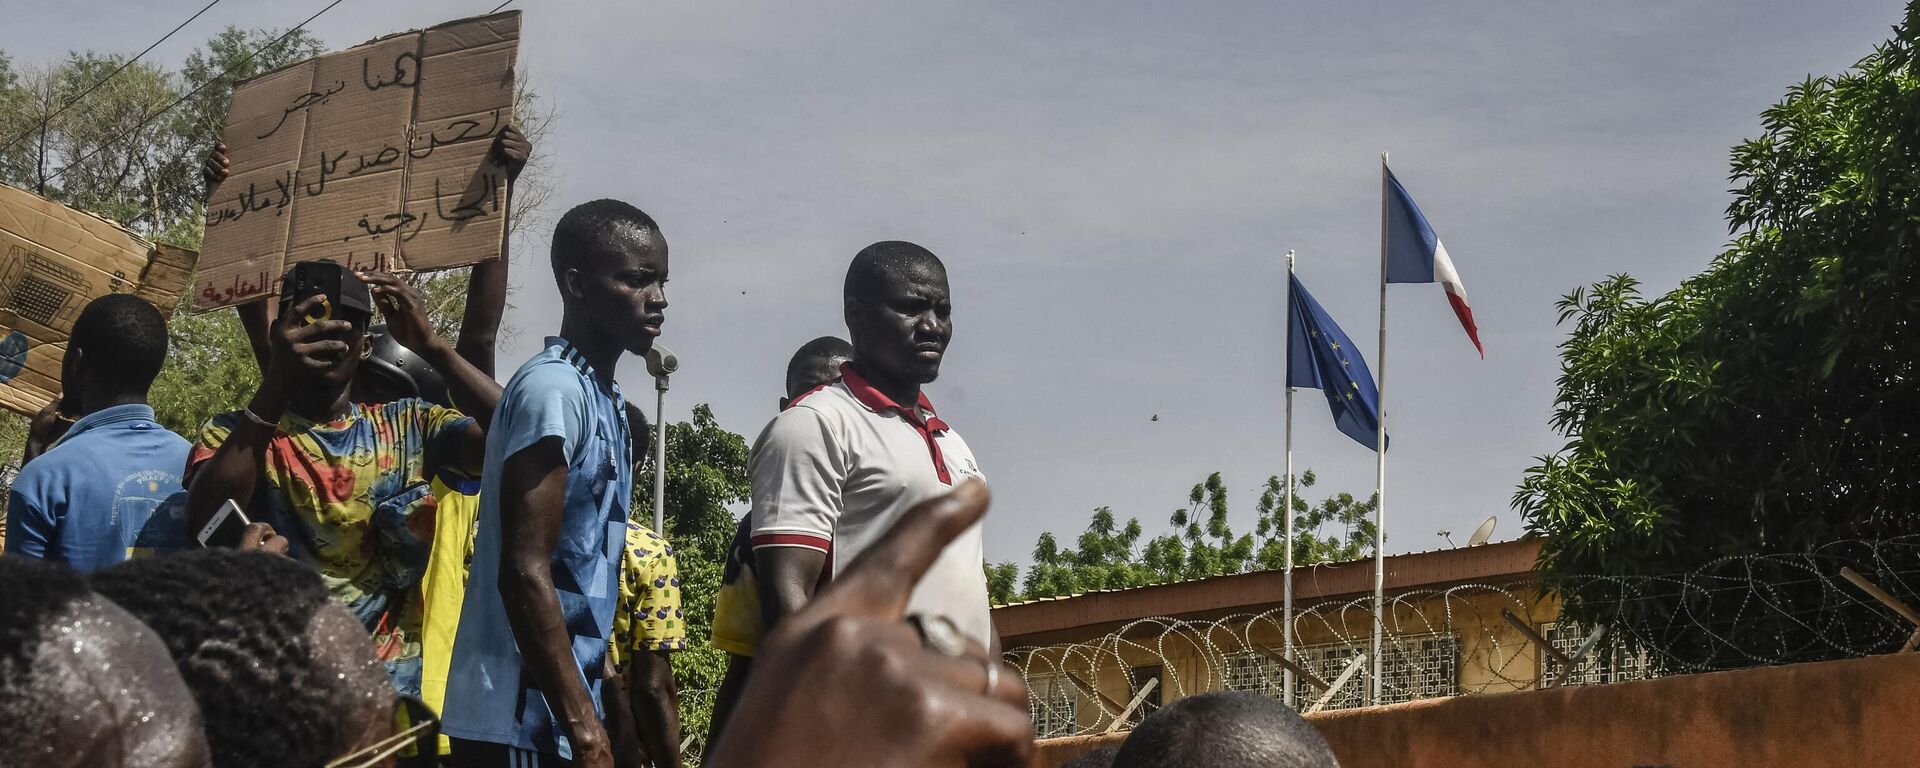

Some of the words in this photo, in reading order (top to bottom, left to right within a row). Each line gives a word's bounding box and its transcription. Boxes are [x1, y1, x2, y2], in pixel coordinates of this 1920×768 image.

[409, 109, 499, 159] نحن
[307, 150, 348, 197] كل
[348, 144, 401, 175] ضد
